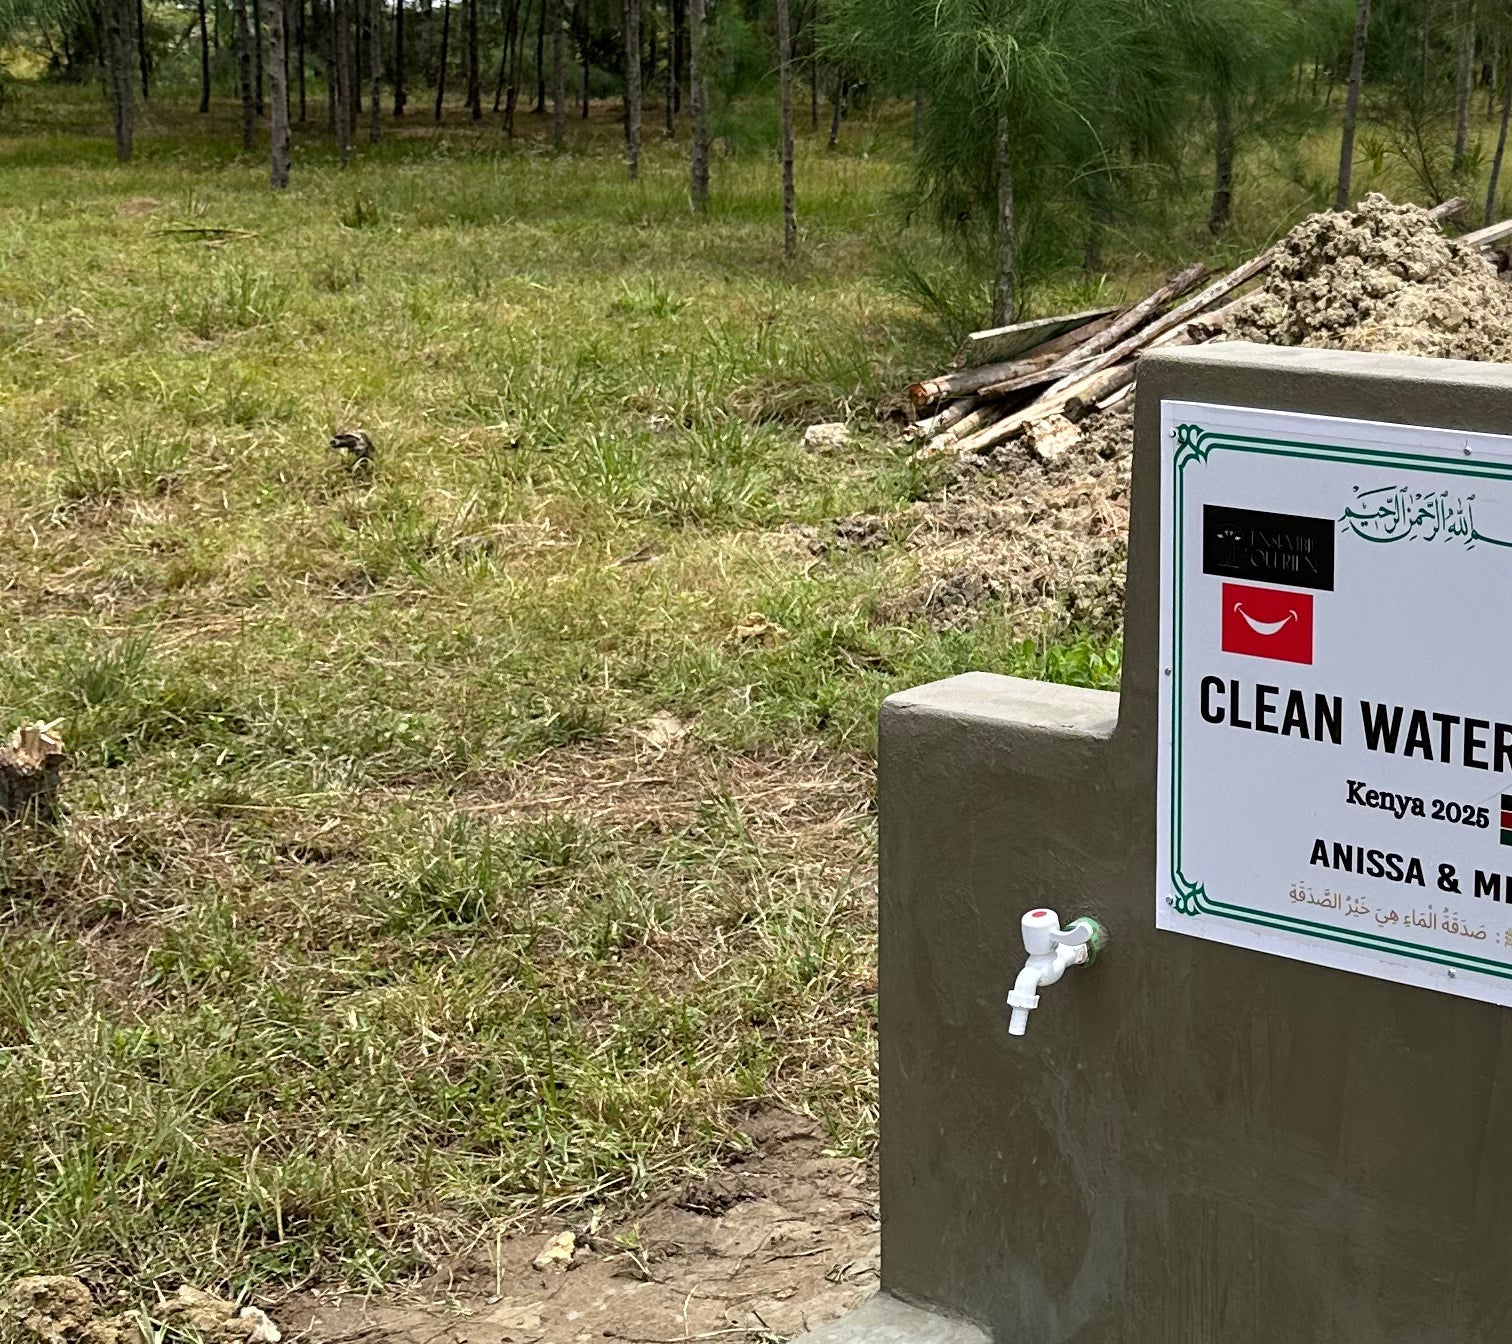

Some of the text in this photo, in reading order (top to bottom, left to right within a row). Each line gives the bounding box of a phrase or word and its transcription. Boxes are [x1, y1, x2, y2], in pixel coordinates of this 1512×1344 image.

[1200, 675, 1343, 746] CLEAN
[1345, 779, 1490, 829] Kenya 2025
[1309, 838, 1426, 888] ANISSA
[1436, 863, 1463, 895] &
